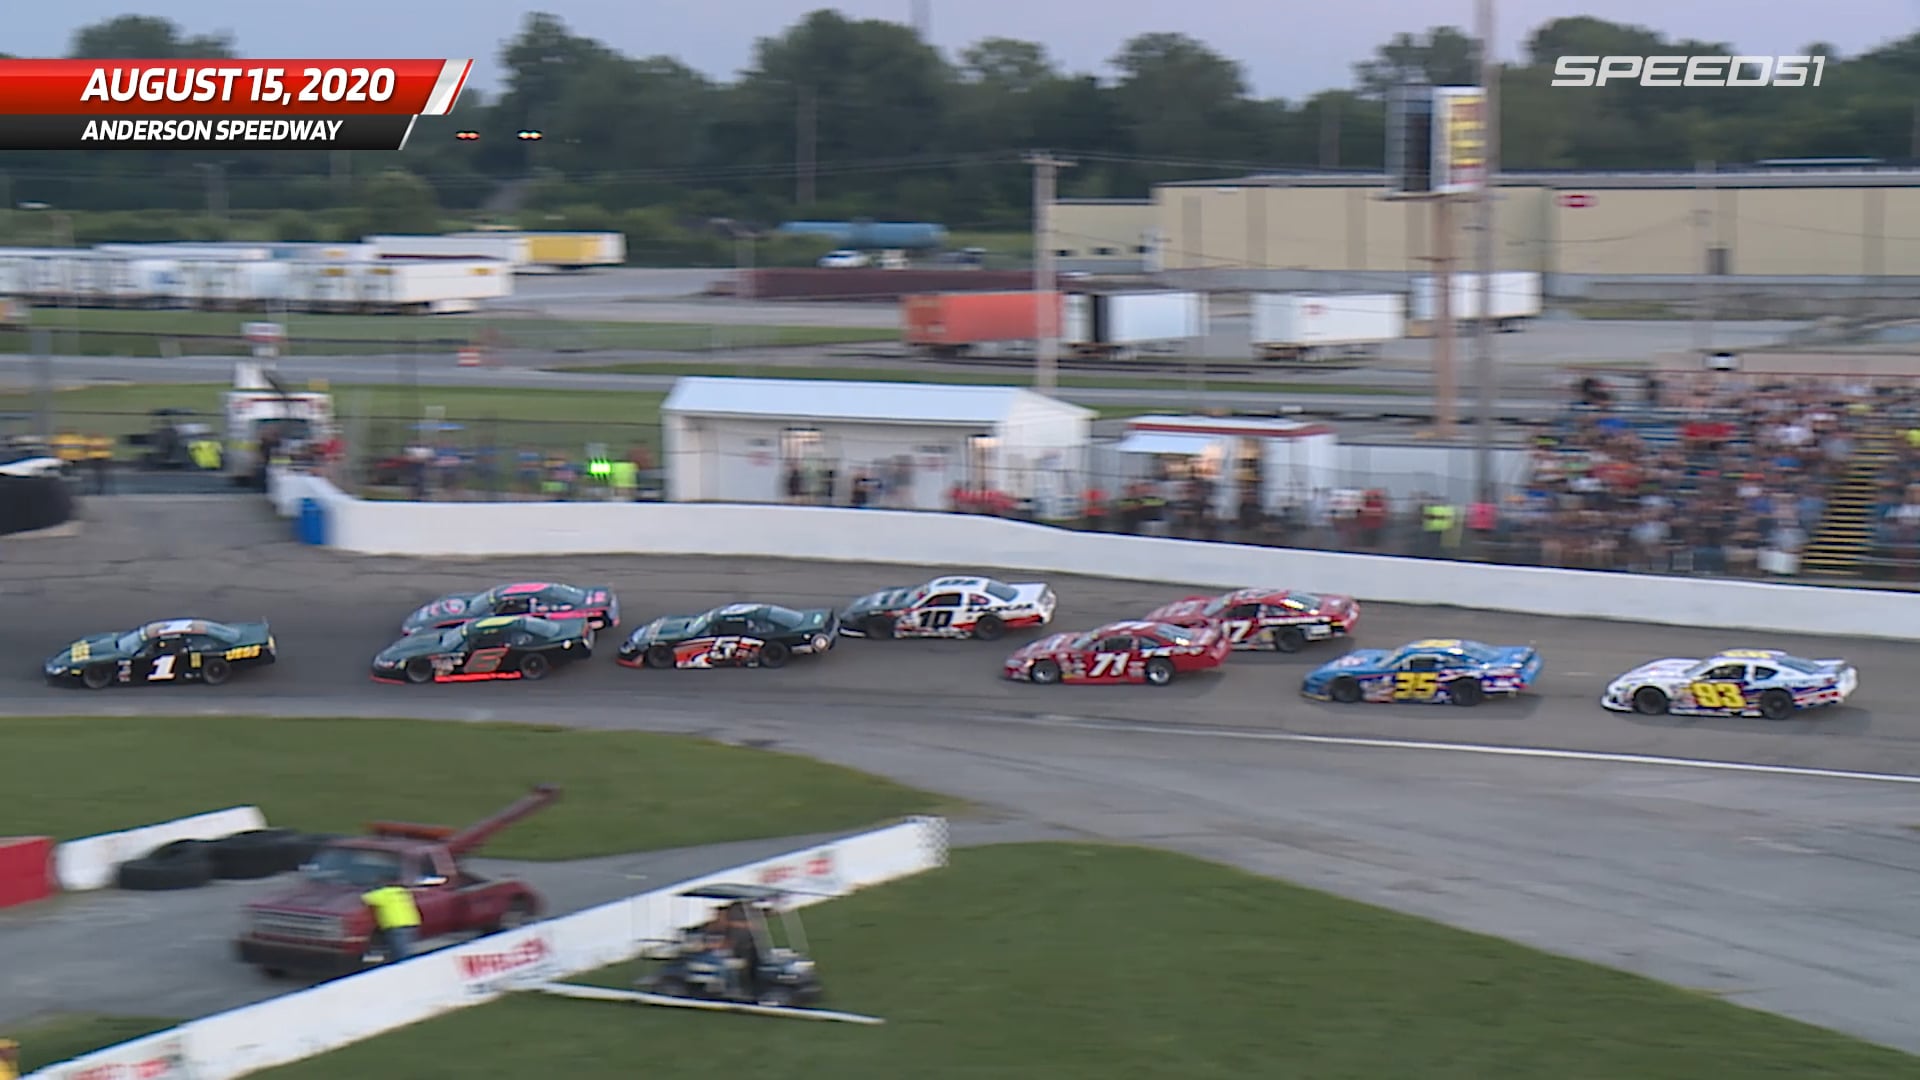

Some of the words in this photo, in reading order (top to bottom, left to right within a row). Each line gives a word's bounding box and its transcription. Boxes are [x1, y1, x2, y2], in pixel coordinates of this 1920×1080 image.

[918, 609, 954, 630] 10
[147, 654, 177, 682] 1
[1087, 652, 1131, 678] 71
[1394, 671, 1439, 699] 35
[1690, 681, 1747, 709] 93
